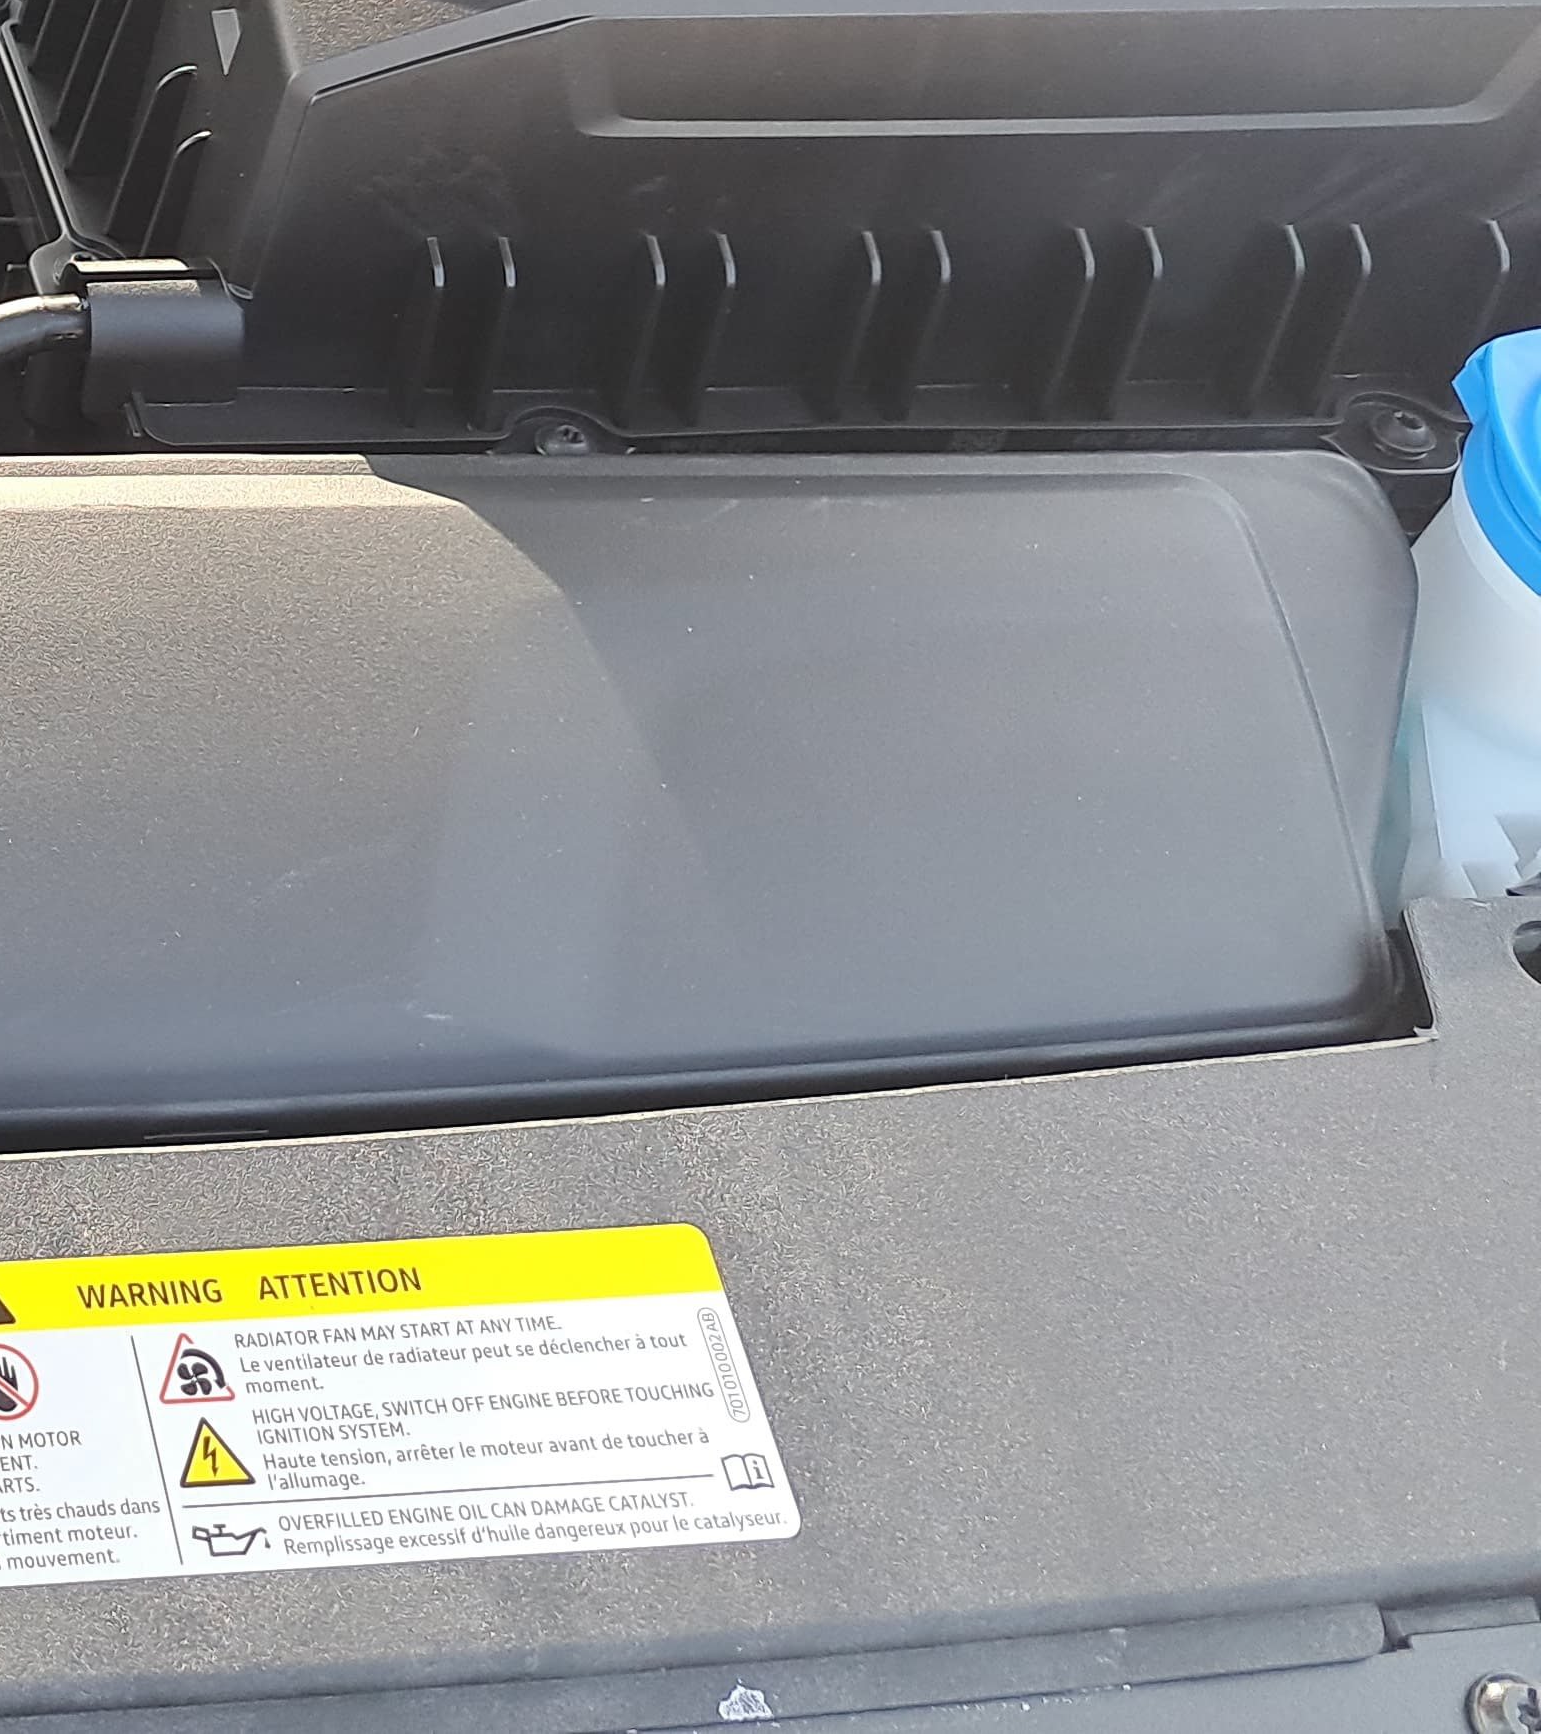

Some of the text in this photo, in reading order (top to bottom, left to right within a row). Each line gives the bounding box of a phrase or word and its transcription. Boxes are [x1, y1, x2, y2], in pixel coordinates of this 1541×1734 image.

[77, 1267, 421, 1308] WARNING ATTENTION
[235, 1330, 319, 1348] RADIATOR
[323, 1328, 356, 1343] FAN
[361, 1325, 394, 1341] MAY
[400, 1322, 449, 1338] START
[457, 1320, 473, 1335] AT
[481, 1318, 510, 1333] ANY
[240, 1334, 687, 1372] Le ventilateur de radiateur peut se déclencher à tout
[252, 1382, 714, 1424] HIGH VOLTAGE, SWITCH OFF ENGINE BEFORE TOUCHING
[18, 1431, 81, 1448] MOTOR
[257, 1422, 410, 1444] IGNITION SYSTEM.
[263, 1428, 709, 1470] Haute tension, arrêter le moteur avant de toucher à
[268, 1472, 365, 1490] l'allumage.
[19, 1504, 52, 1521] très
[57, 1500, 116, 1519] chauds
[121, 1498, 160, 1515] dans
[279, 1492, 693, 1531] OVERFILLED ENGINE OIL CAN DAMAGE CATALYST.
[68, 1526, 137, 1542] moteur.
